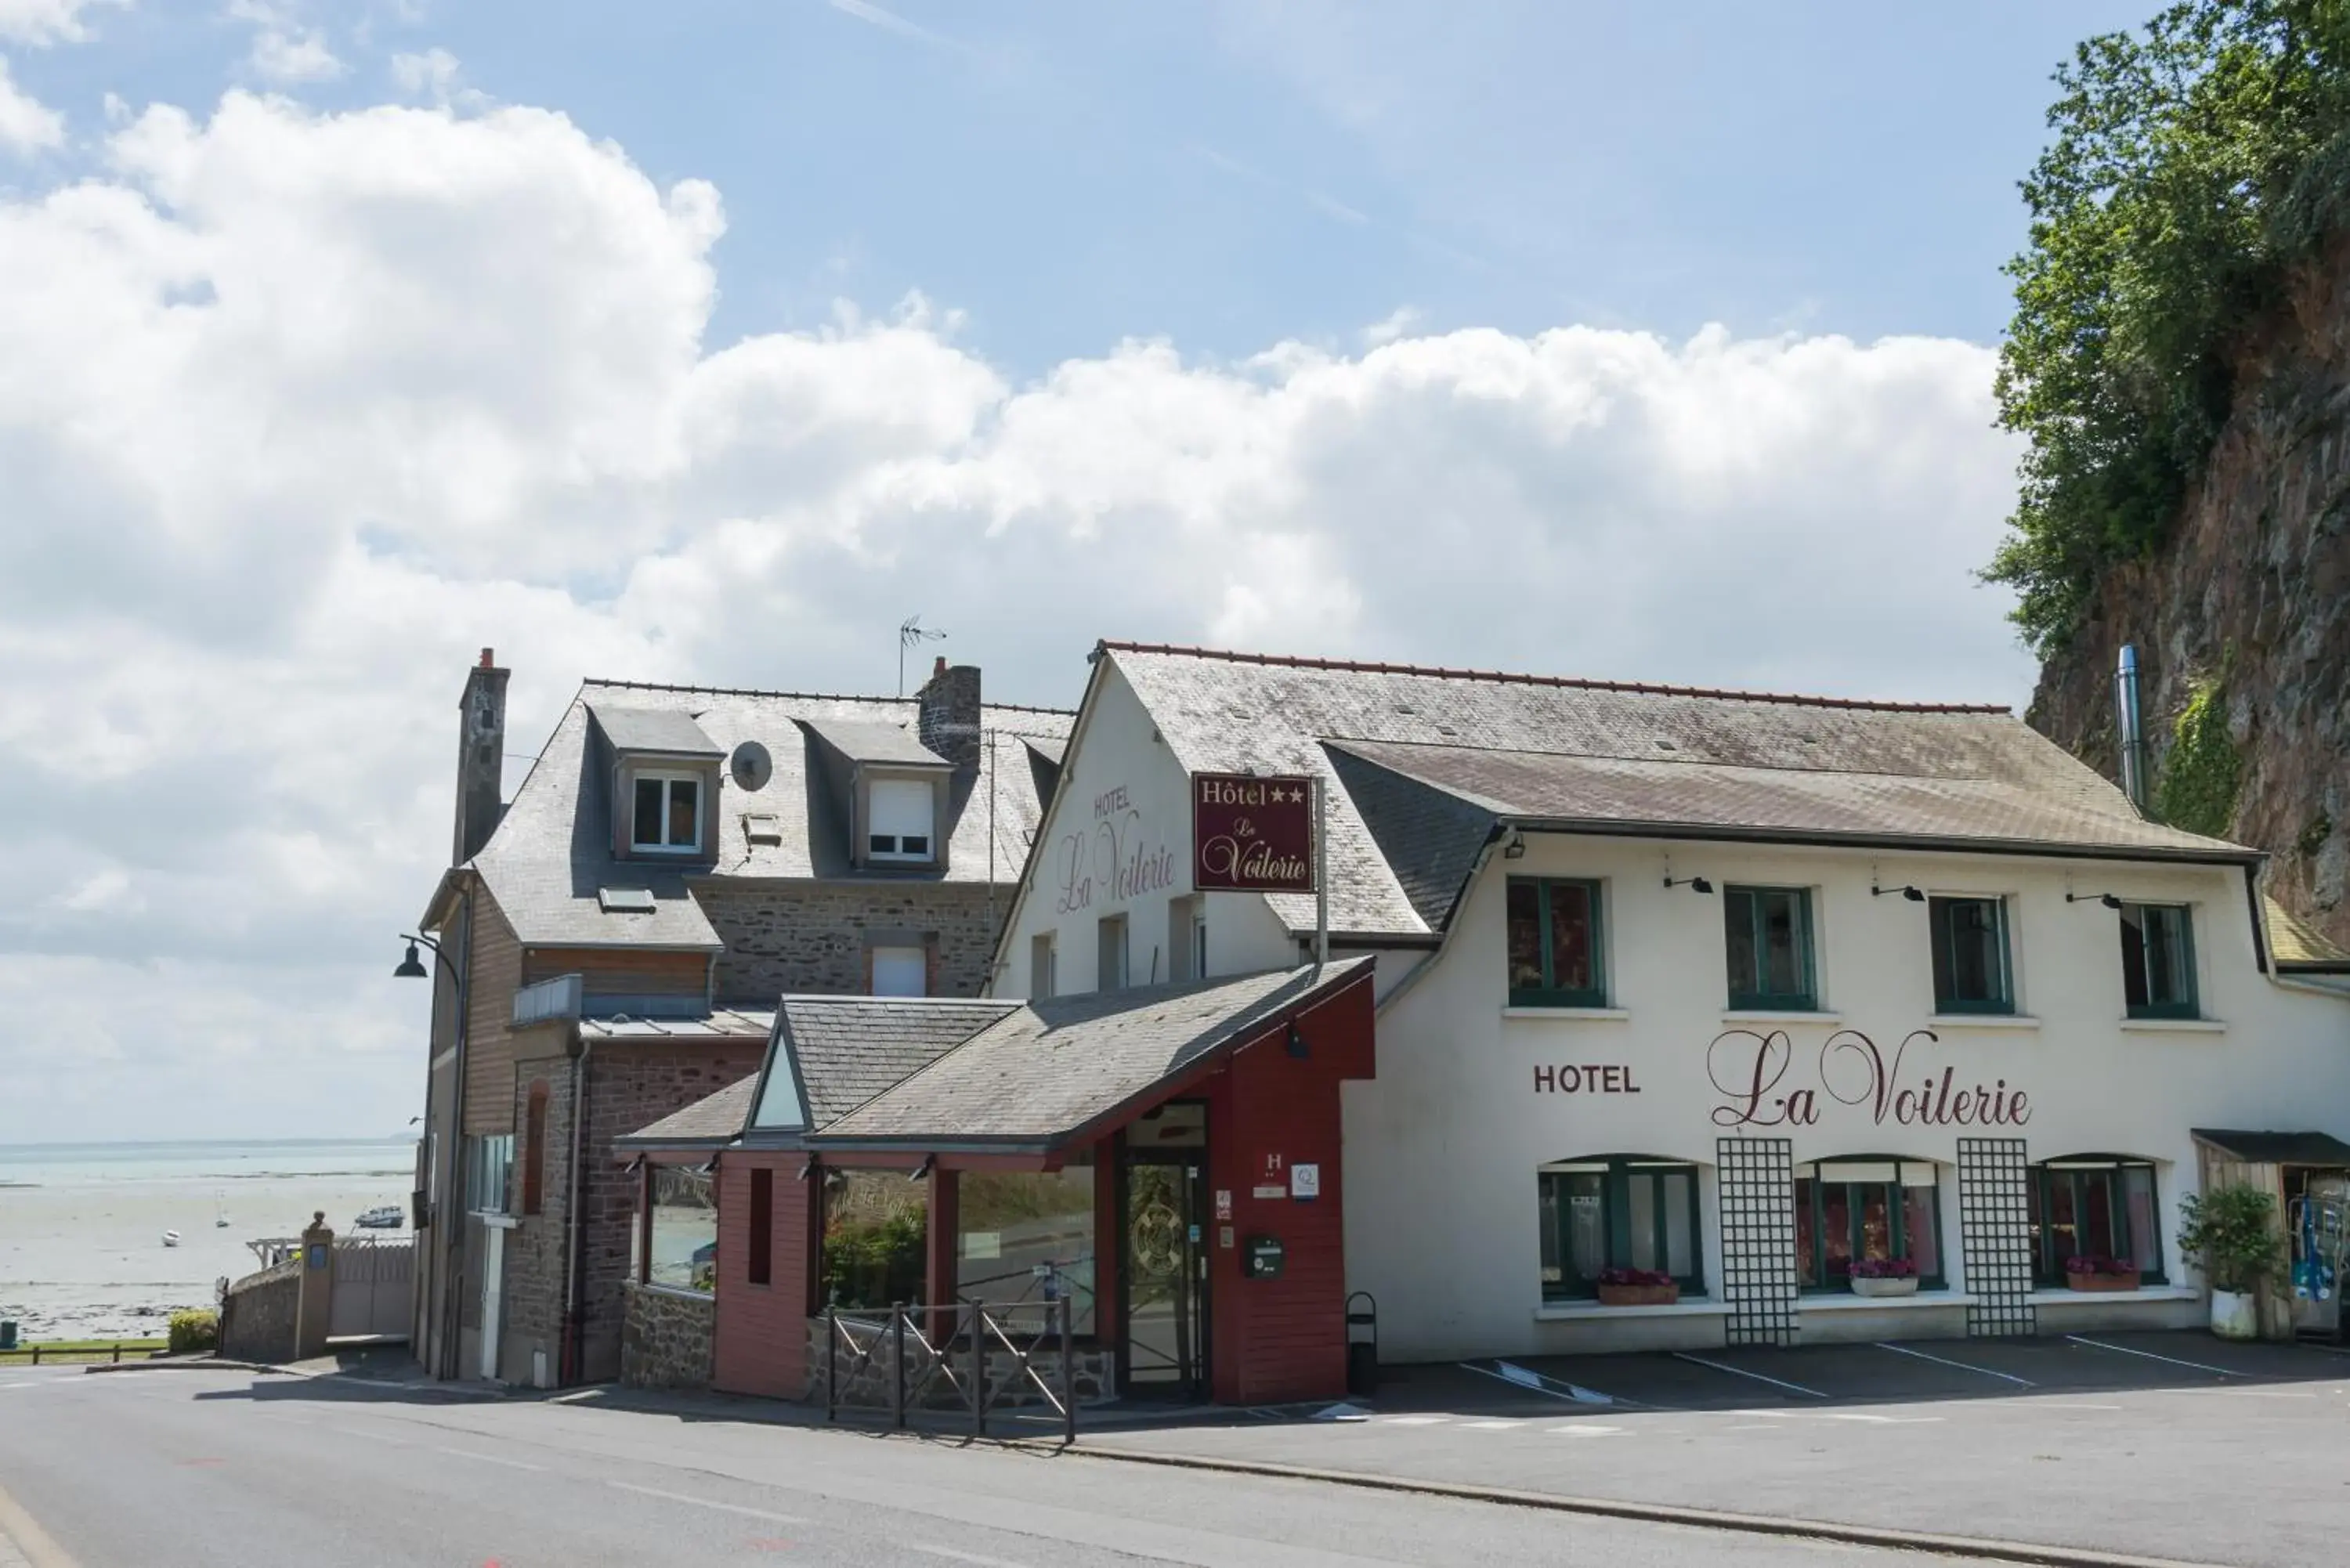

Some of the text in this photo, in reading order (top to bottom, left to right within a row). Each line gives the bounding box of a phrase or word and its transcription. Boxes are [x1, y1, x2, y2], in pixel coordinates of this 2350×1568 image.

[1094, 784, 1130, 819] HOTEL
[1202, 781, 1266, 806] Hôtel
[1233, 817, 1256, 837] La
[1057, 809, 1176, 914] La Voilerie
[1202, 835, 1306, 883] Voilerie
[1533, 1064, 1641, 1093] HOTEL
[1707, 1030, 2033, 1125] La Voilerie
[1267, 1154, 1282, 1170] H
